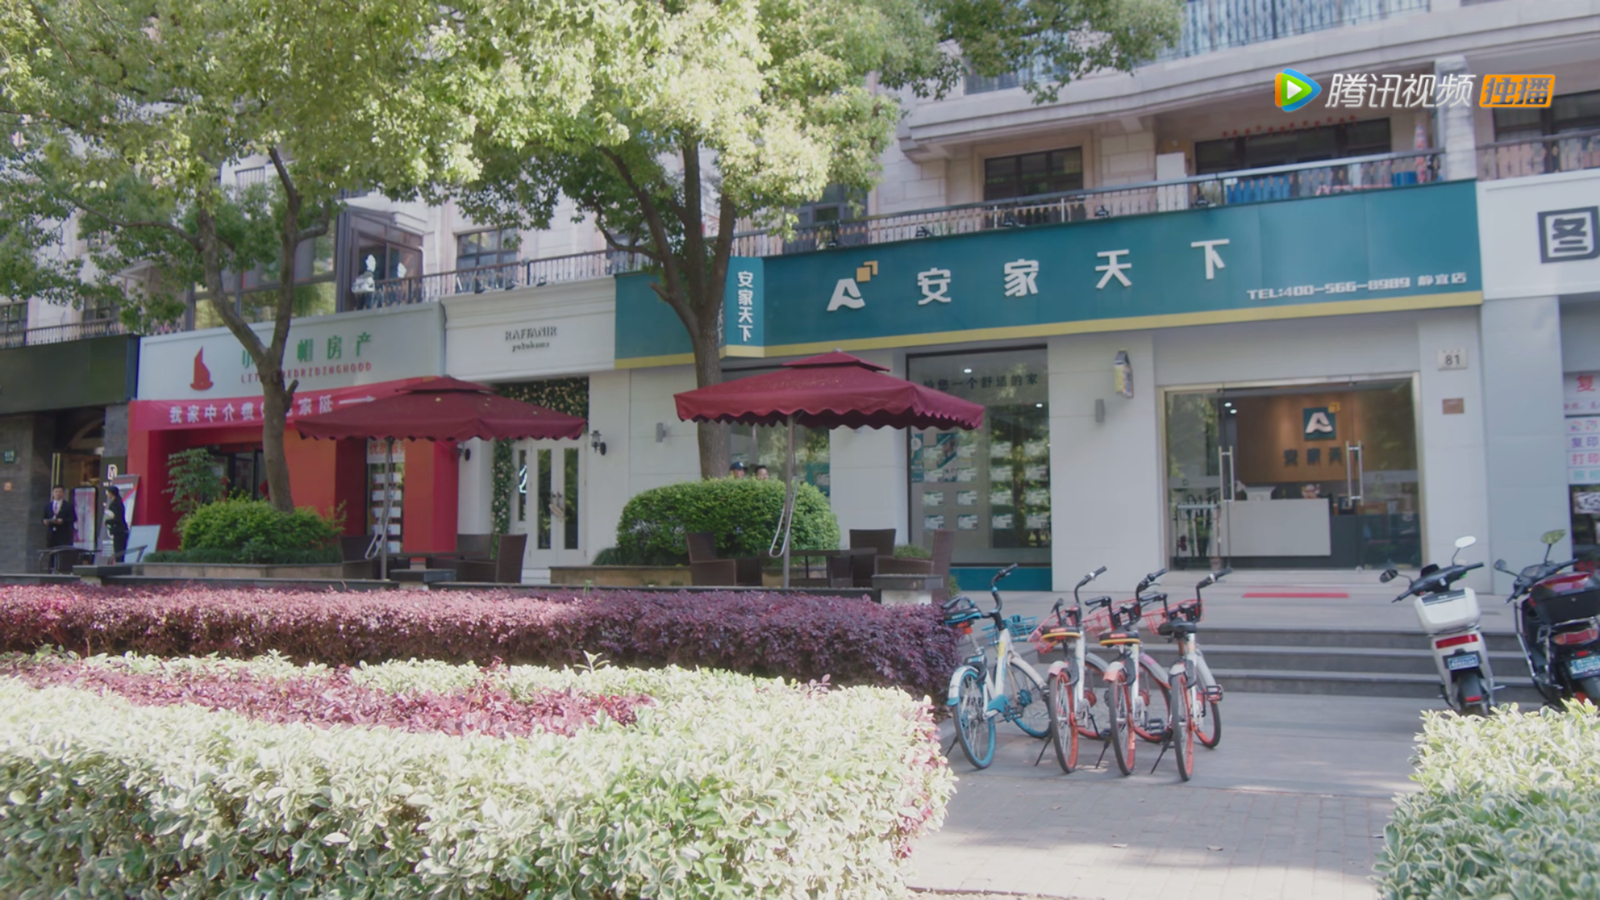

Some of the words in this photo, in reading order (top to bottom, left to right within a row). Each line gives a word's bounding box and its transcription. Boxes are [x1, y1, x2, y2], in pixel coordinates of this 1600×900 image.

[1537, 205, 1600, 264] 图
[917, 238, 1230, 305] 安家天下
[737, 270, 754, 343] 安家天下
[1445, 353, 1460, 366] 81
